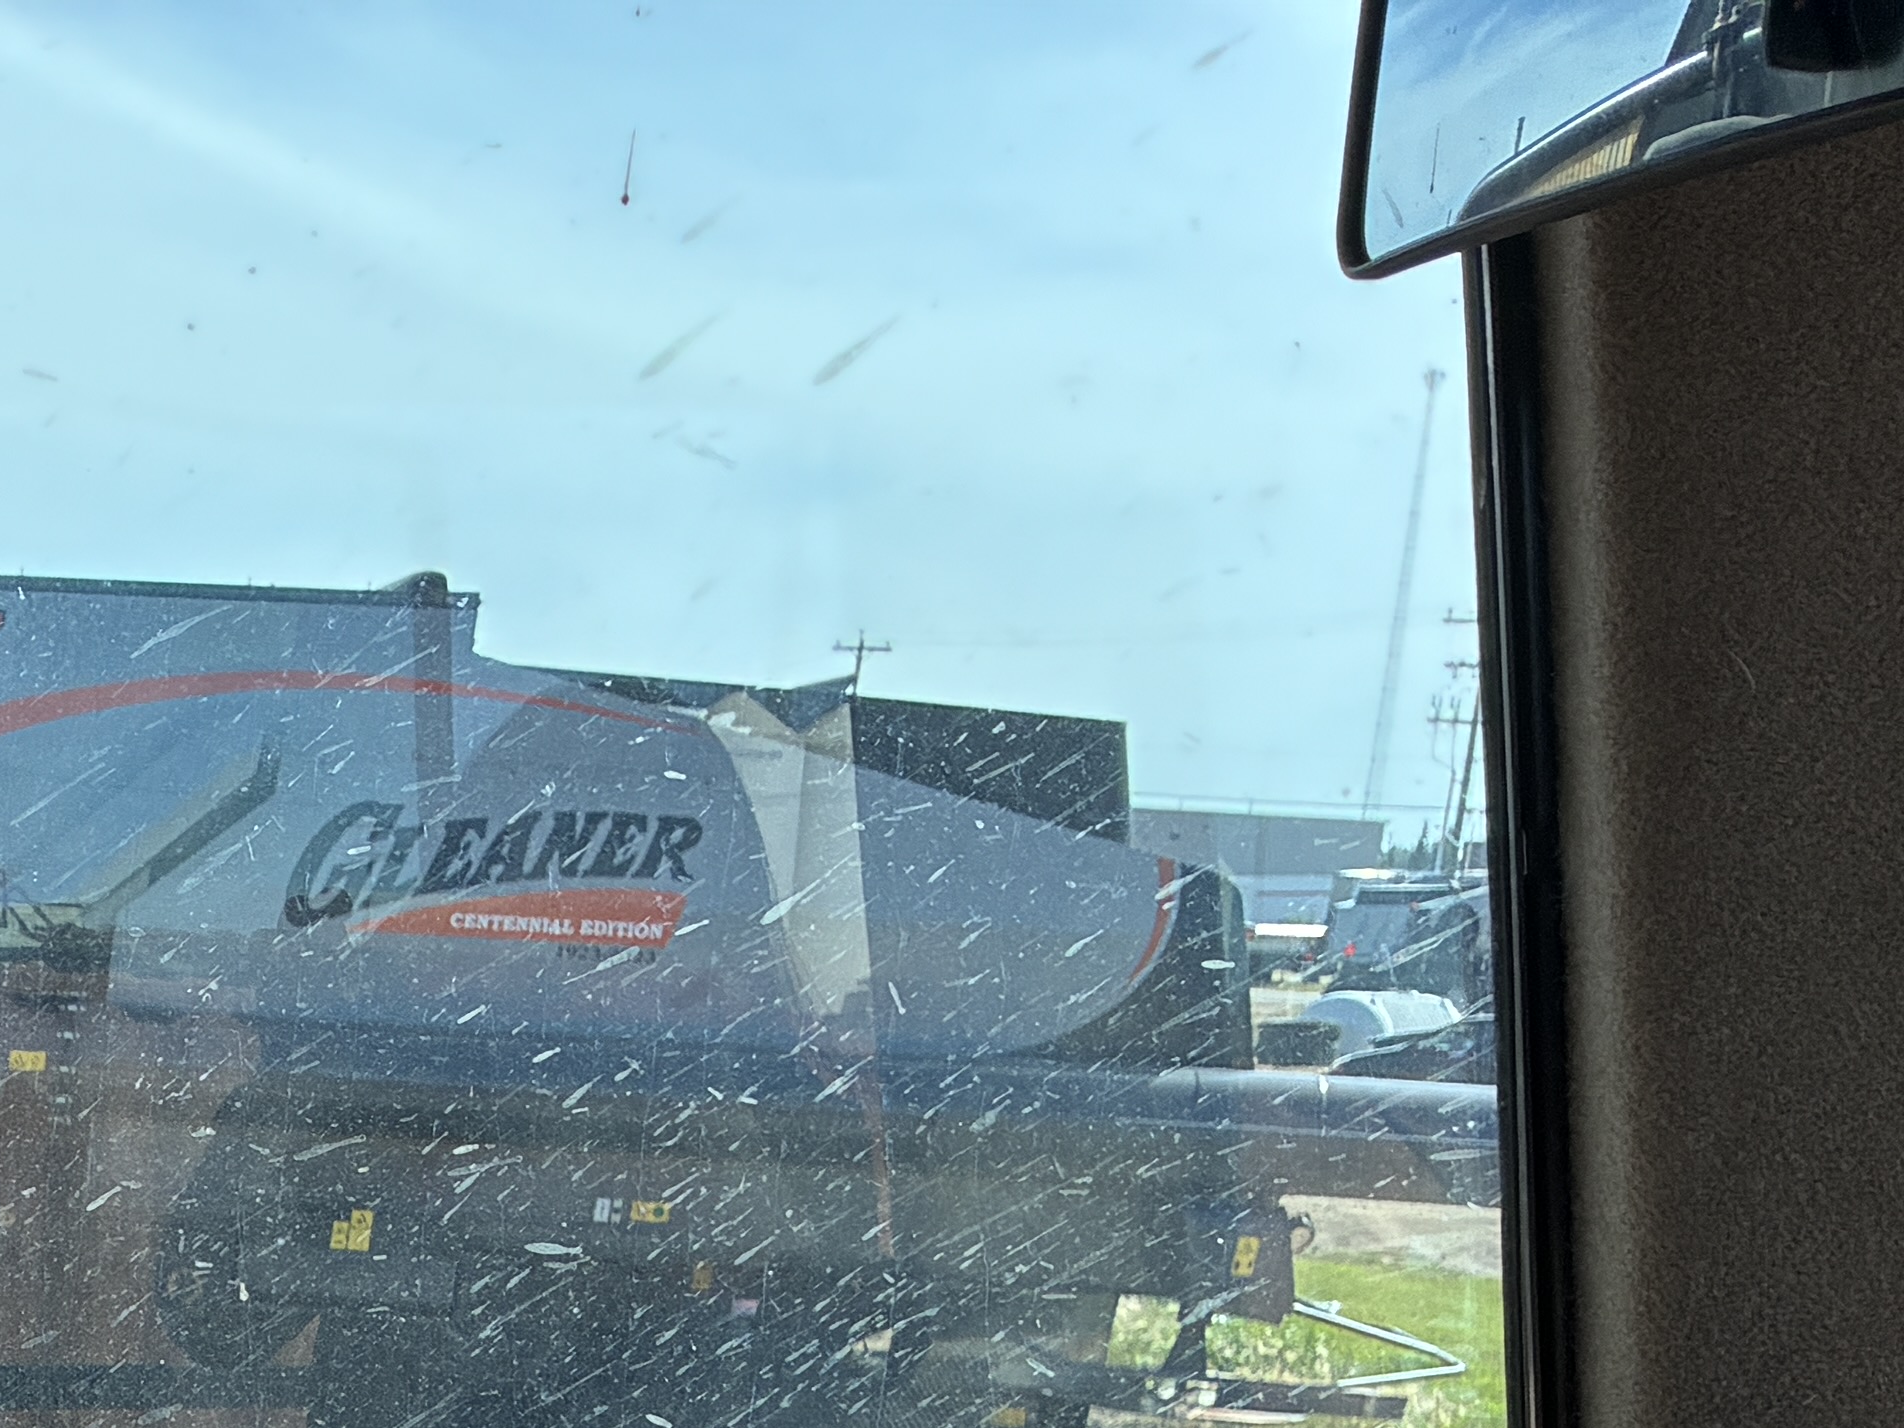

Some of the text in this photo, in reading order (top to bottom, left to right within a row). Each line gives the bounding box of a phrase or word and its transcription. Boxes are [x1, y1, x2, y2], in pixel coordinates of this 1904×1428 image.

[284, 799, 704, 927] GLEANER
[450, 912, 665, 940] CENTENNIAL EDITION
